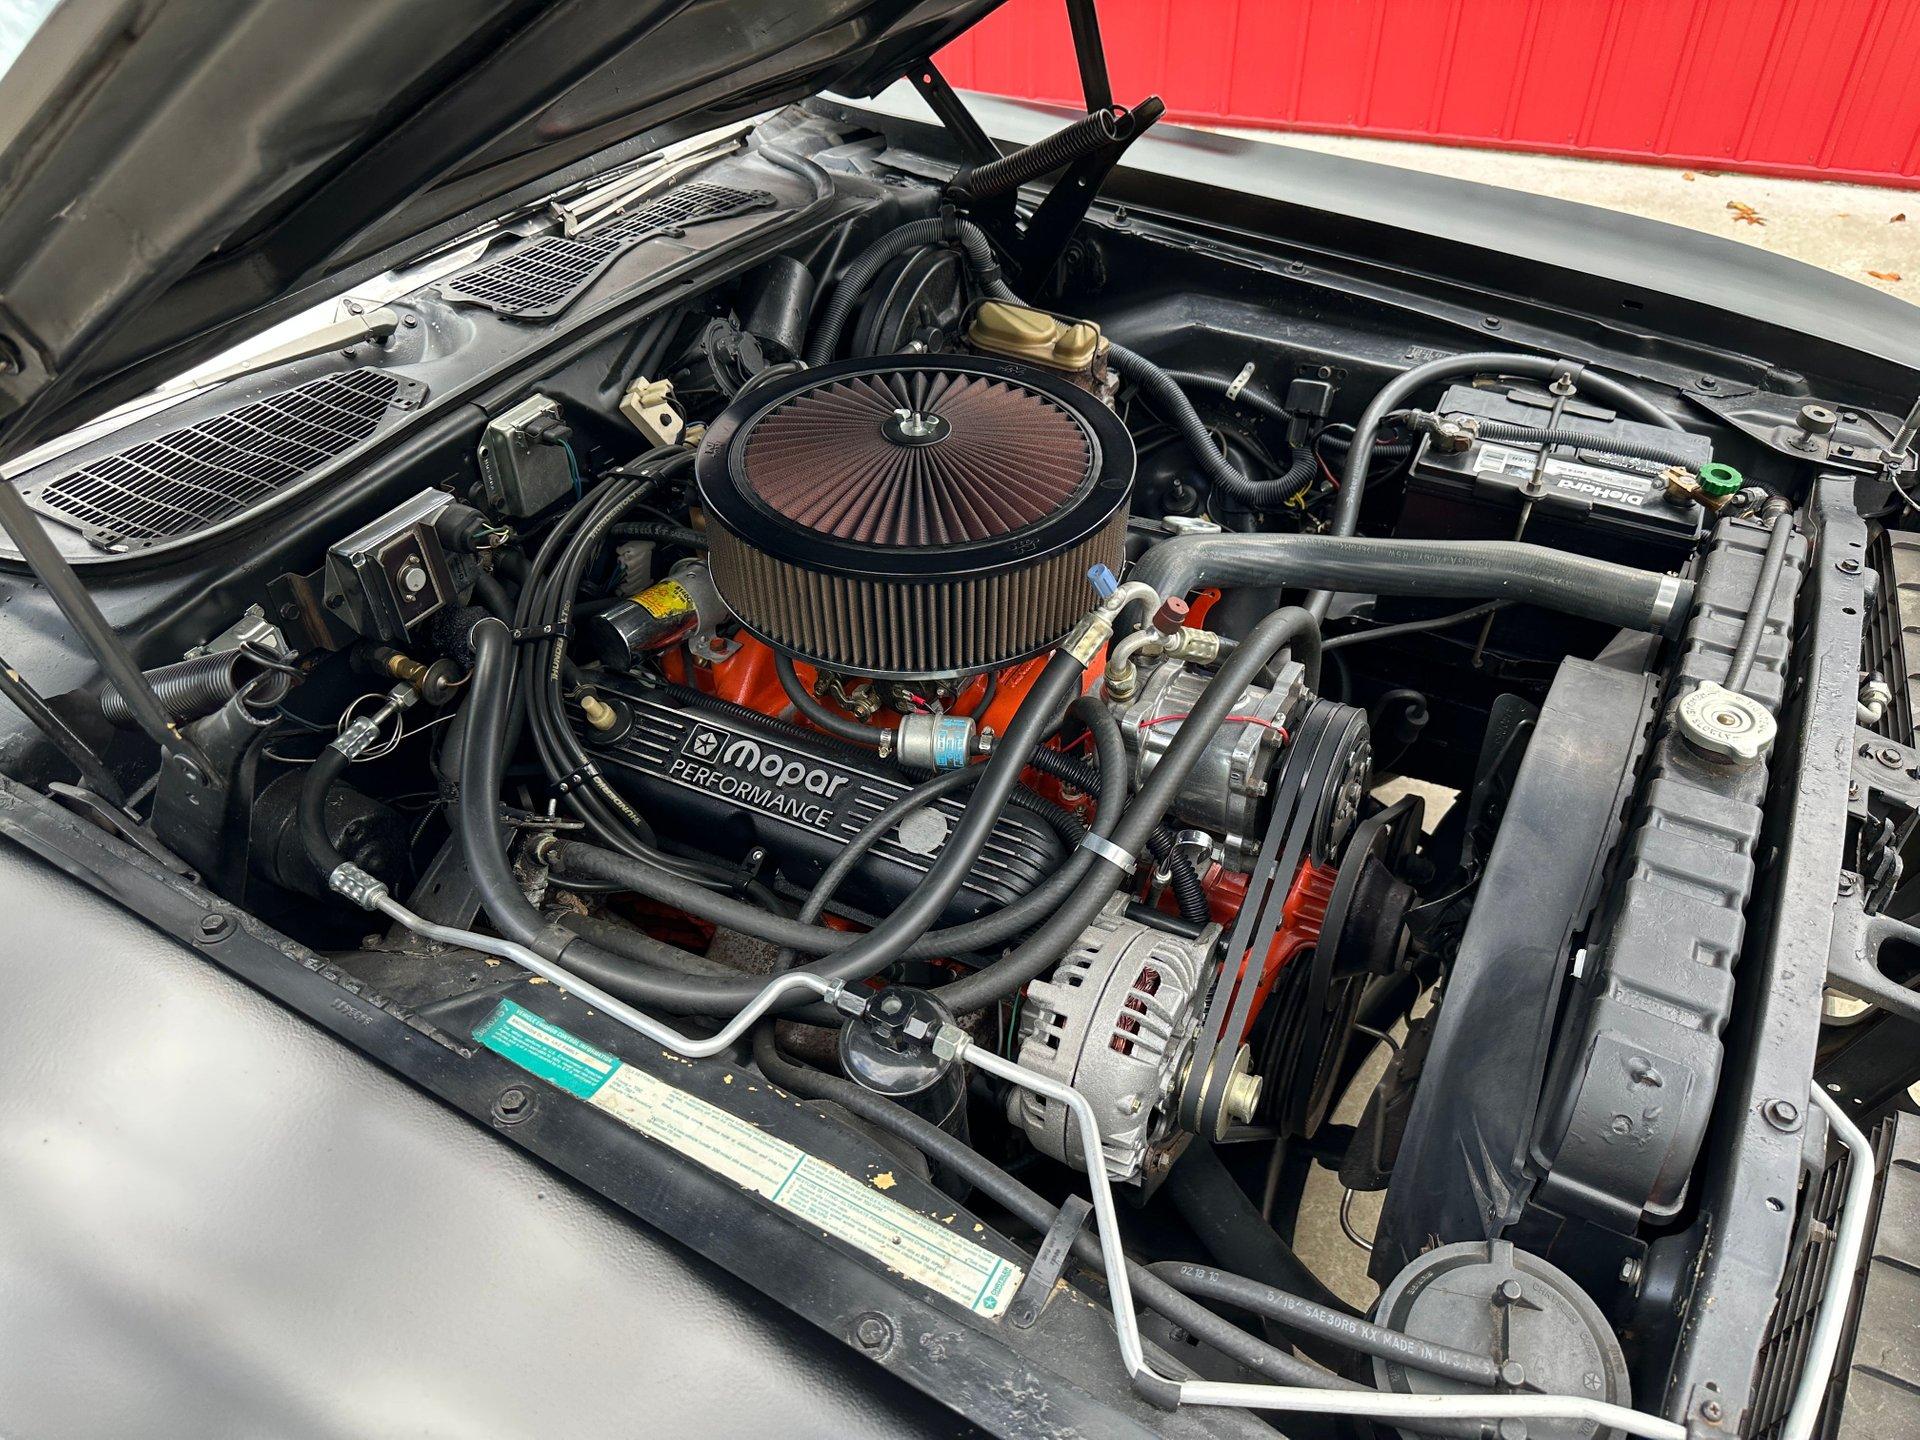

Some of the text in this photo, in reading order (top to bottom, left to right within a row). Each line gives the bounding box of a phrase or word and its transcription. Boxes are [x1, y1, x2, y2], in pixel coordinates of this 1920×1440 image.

[1555, 478, 1644, 506] DieHard
[722, 739, 850, 800] Mopar
[668, 758, 835, 830] PERFORMANCE
[1380, 1332, 1416, 1355] MADE
[1419, 1345, 1434, 1360] IN
